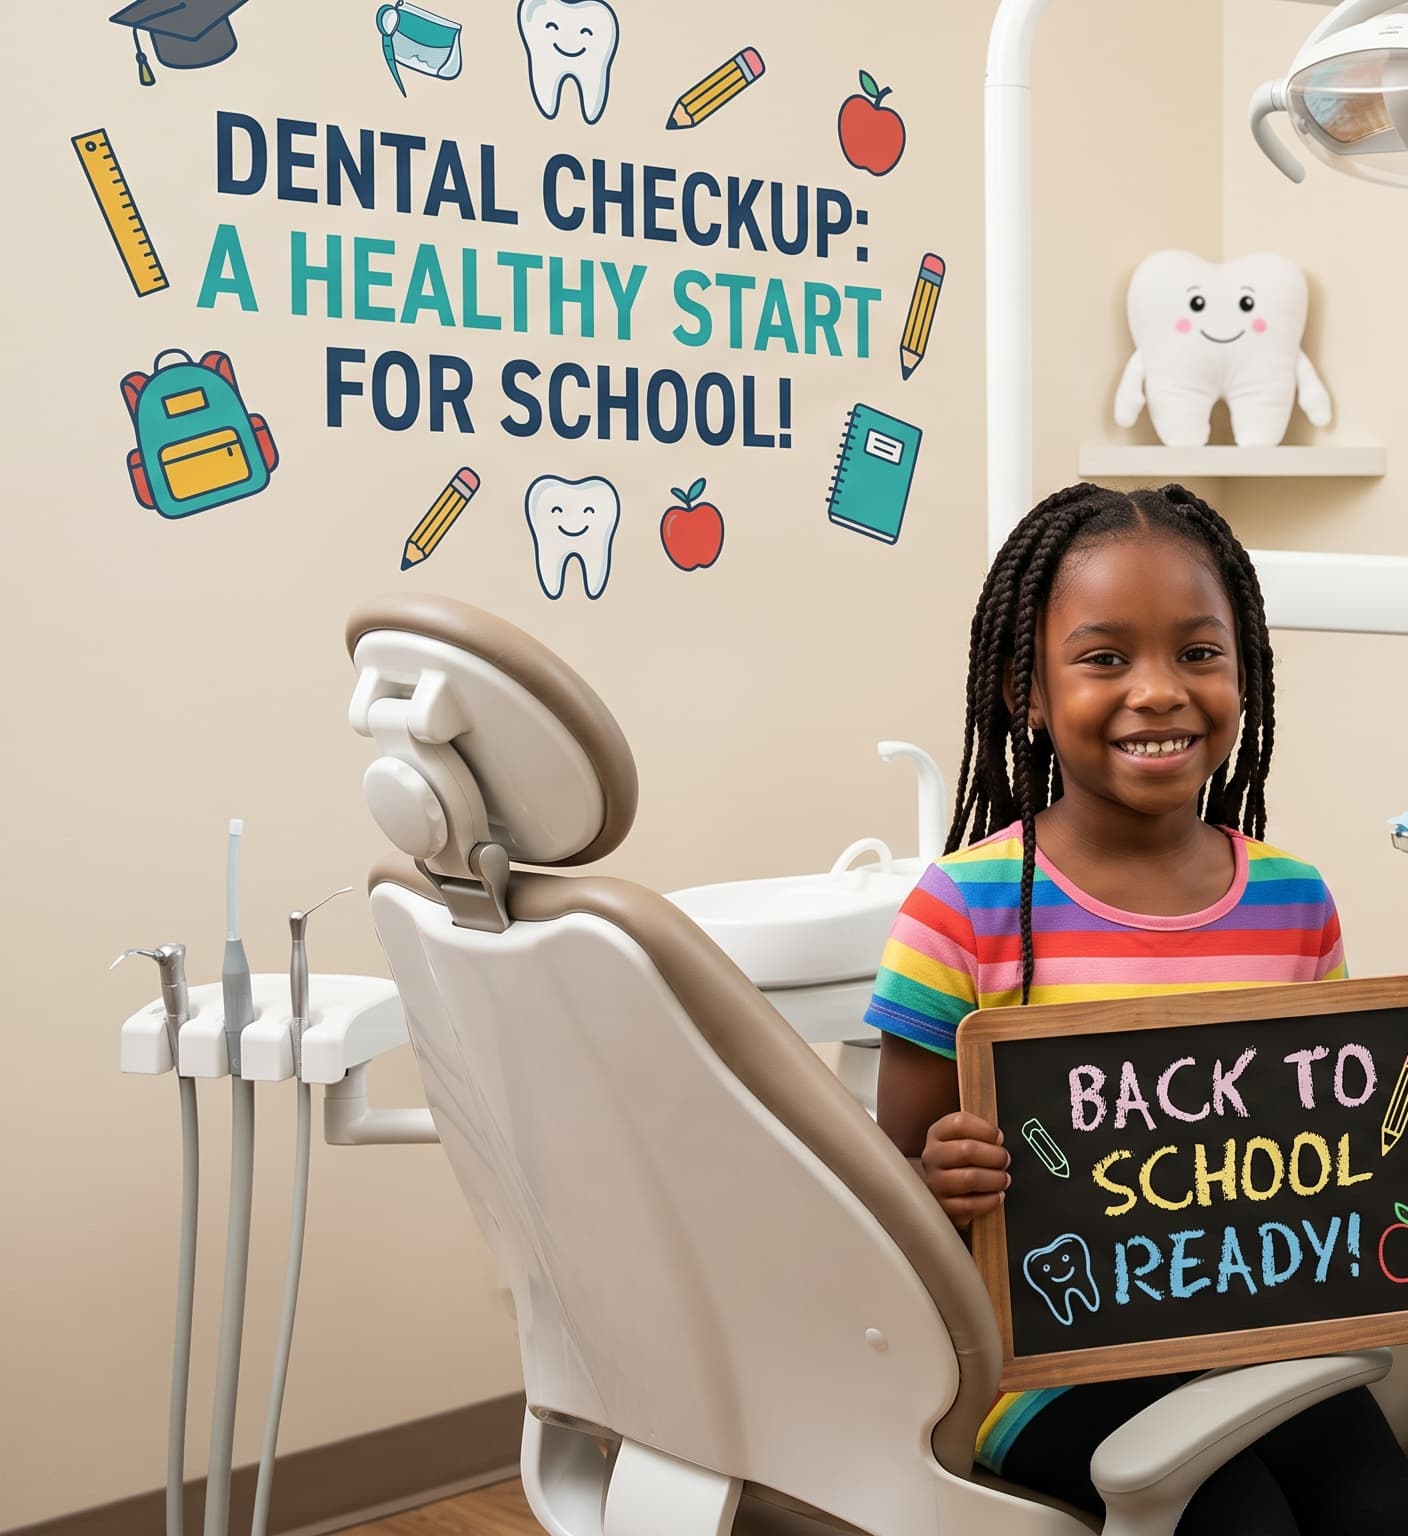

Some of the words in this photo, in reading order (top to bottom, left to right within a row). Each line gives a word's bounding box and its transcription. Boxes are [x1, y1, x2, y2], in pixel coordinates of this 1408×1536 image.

[216, 110, 519, 226] DENTAL
[542, 153, 868, 263] CHECKUP:
[197, 223, 259, 312] A
[290, 231, 647, 340] HEALTHY
[672, 269, 882, 358] START
[326, 346, 476, 434] FOR
[500, 359, 792, 449] SCHOOL!
[1068, 1045, 1257, 1132] BACK
[1284, 1042, 1378, 1110] TO
[1091, 1130, 1374, 1217] SCHOOL
[1114, 1211, 1361, 1305] READY!
